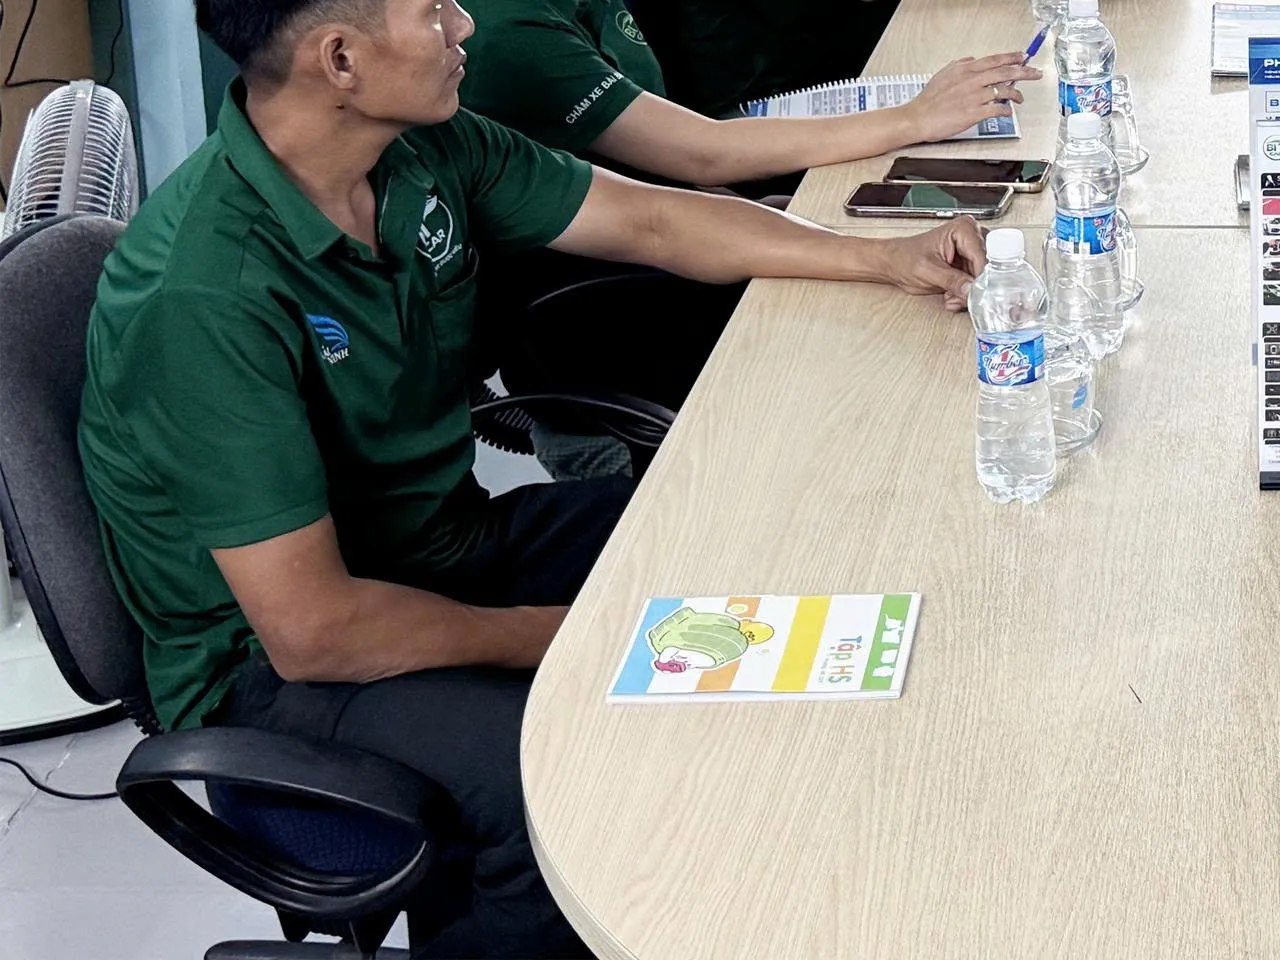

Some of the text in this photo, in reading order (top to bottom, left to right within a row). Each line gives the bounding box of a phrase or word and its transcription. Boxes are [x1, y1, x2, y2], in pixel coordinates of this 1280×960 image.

[589, 86, 604, 101] XE
[828, 635, 862, 684] Tập HS
